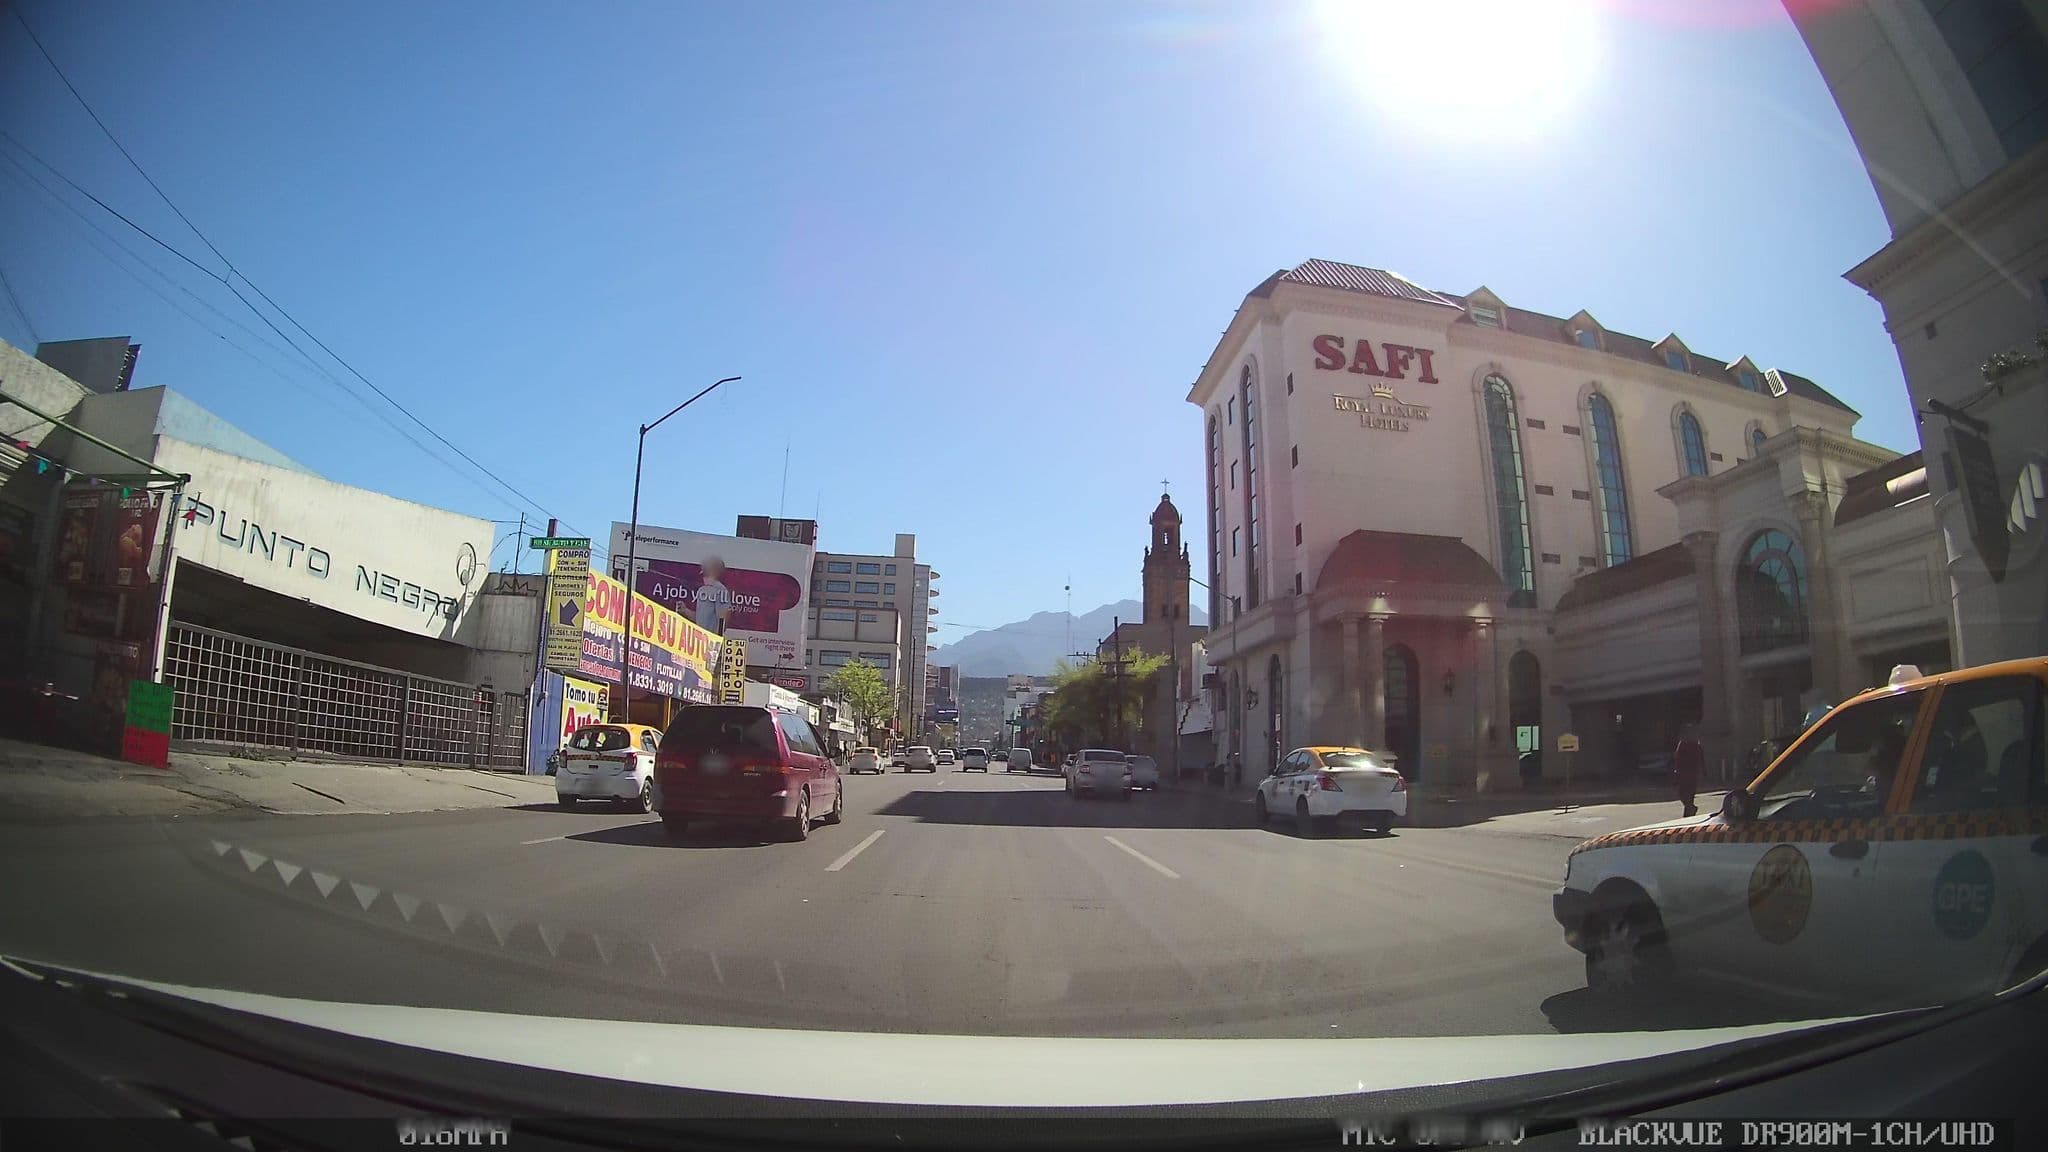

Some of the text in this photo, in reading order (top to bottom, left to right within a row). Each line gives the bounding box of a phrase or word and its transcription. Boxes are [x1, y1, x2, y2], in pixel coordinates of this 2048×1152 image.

[1312, 334, 1439, 384] SAFI
[1334, 396, 1430, 423] ROYAL LUXURY
[1359, 414, 1410, 433] HOTELS
[632, 533, 680, 546] eleperformance
[180, 496, 460, 622] PUNTO NEGRO
[653, 583, 760, 607] A job you'll love
[744, 606, 760, 614] now
[657, 611, 678, 647] SU
[748, 636, 760, 644] Get
[768, 638, 796, 646] interview
[583, 638, 614, 662] Ofertas
[779, 644, 795, 652] there
[724, 640, 733, 688] COMPRO
[734, 648, 744, 688] AUTO
[565, 682, 596, 704] Tomo tu
[628, 672, 674, 695] 1.8331.3018
[1939, 882, 1988, 912] GPE
